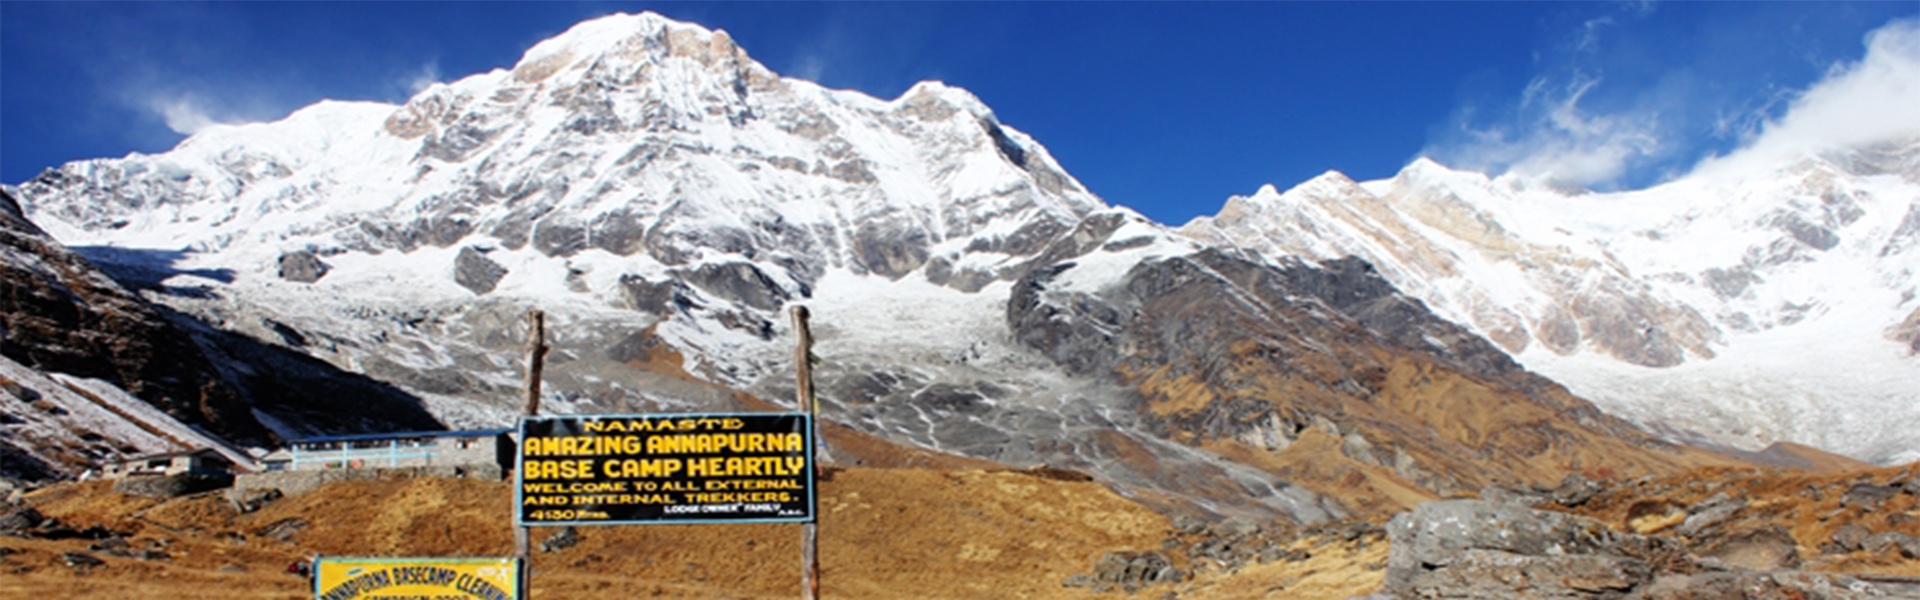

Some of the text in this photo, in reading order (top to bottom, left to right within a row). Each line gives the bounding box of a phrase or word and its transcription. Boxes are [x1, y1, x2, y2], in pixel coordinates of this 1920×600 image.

[584, 418, 744, 431] NAMASTE
[525, 433, 802, 455] AMAZING ANNAPURNA
[525, 456, 804, 479] BASE CAMP HEARTLY
[524, 479, 804, 493] WELCOME TO ALL EXTERNAL
[524, 496, 568, 505] AND
[573, 494, 676, 505] INTERNAL
[664, 505, 700, 513] LODGE
[744, 503, 780, 512] FAMILY
